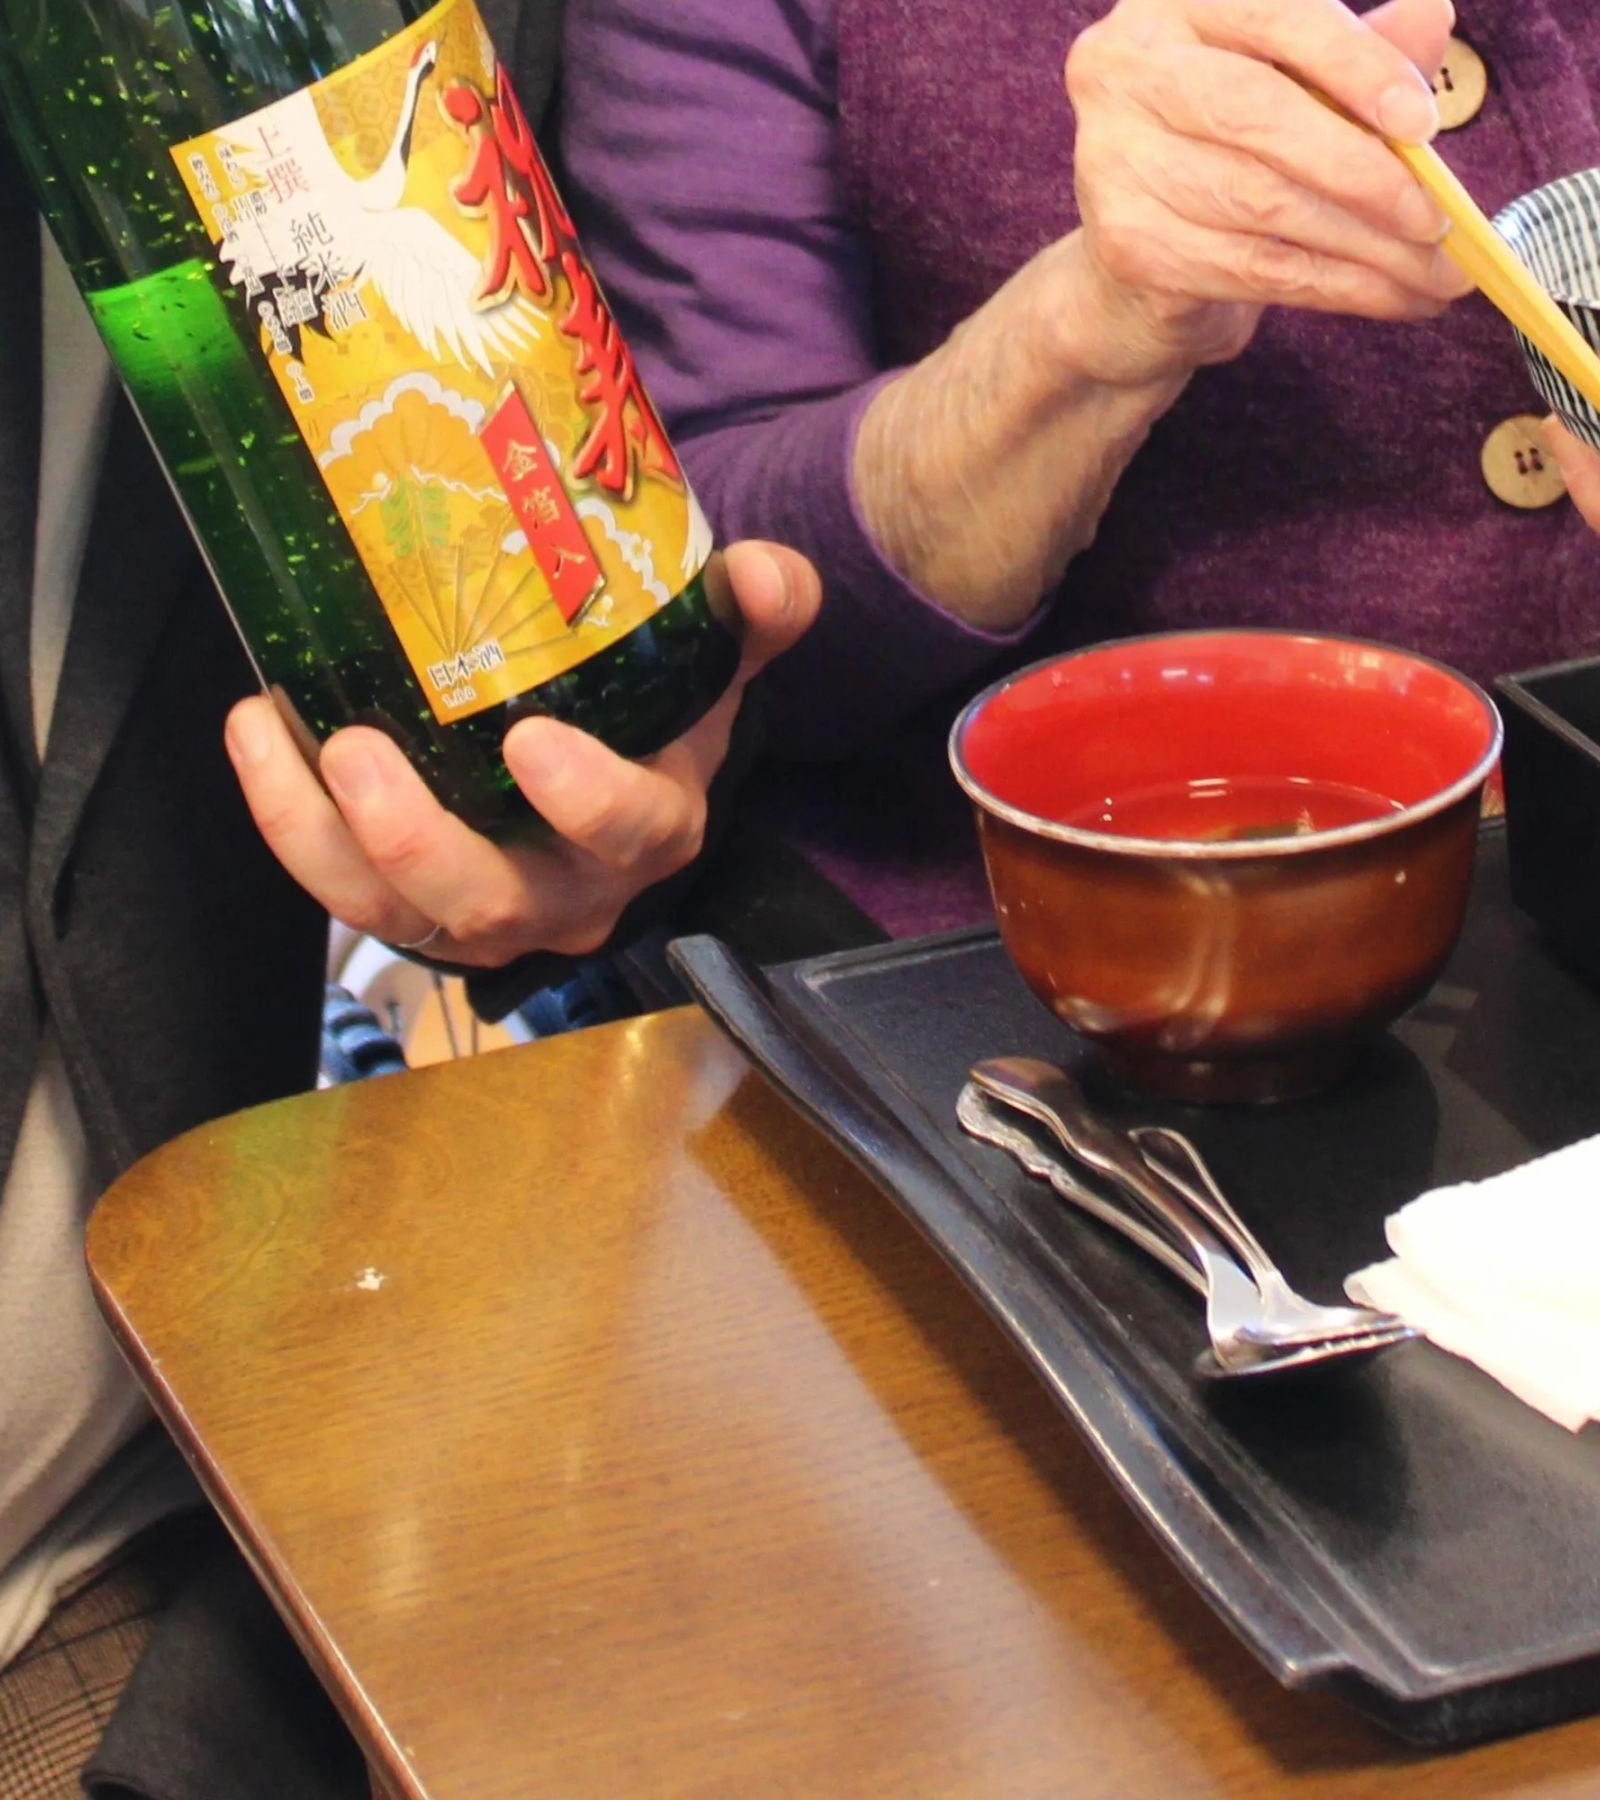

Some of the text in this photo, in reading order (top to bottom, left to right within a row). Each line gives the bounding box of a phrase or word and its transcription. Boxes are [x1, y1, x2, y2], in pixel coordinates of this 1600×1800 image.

[254, 126, 310, 203] 上撰
[289, 211, 368, 331] 純米酒
[503, 439, 587, 579] 金箔入
[428, 643, 504, 687] 日本酒
